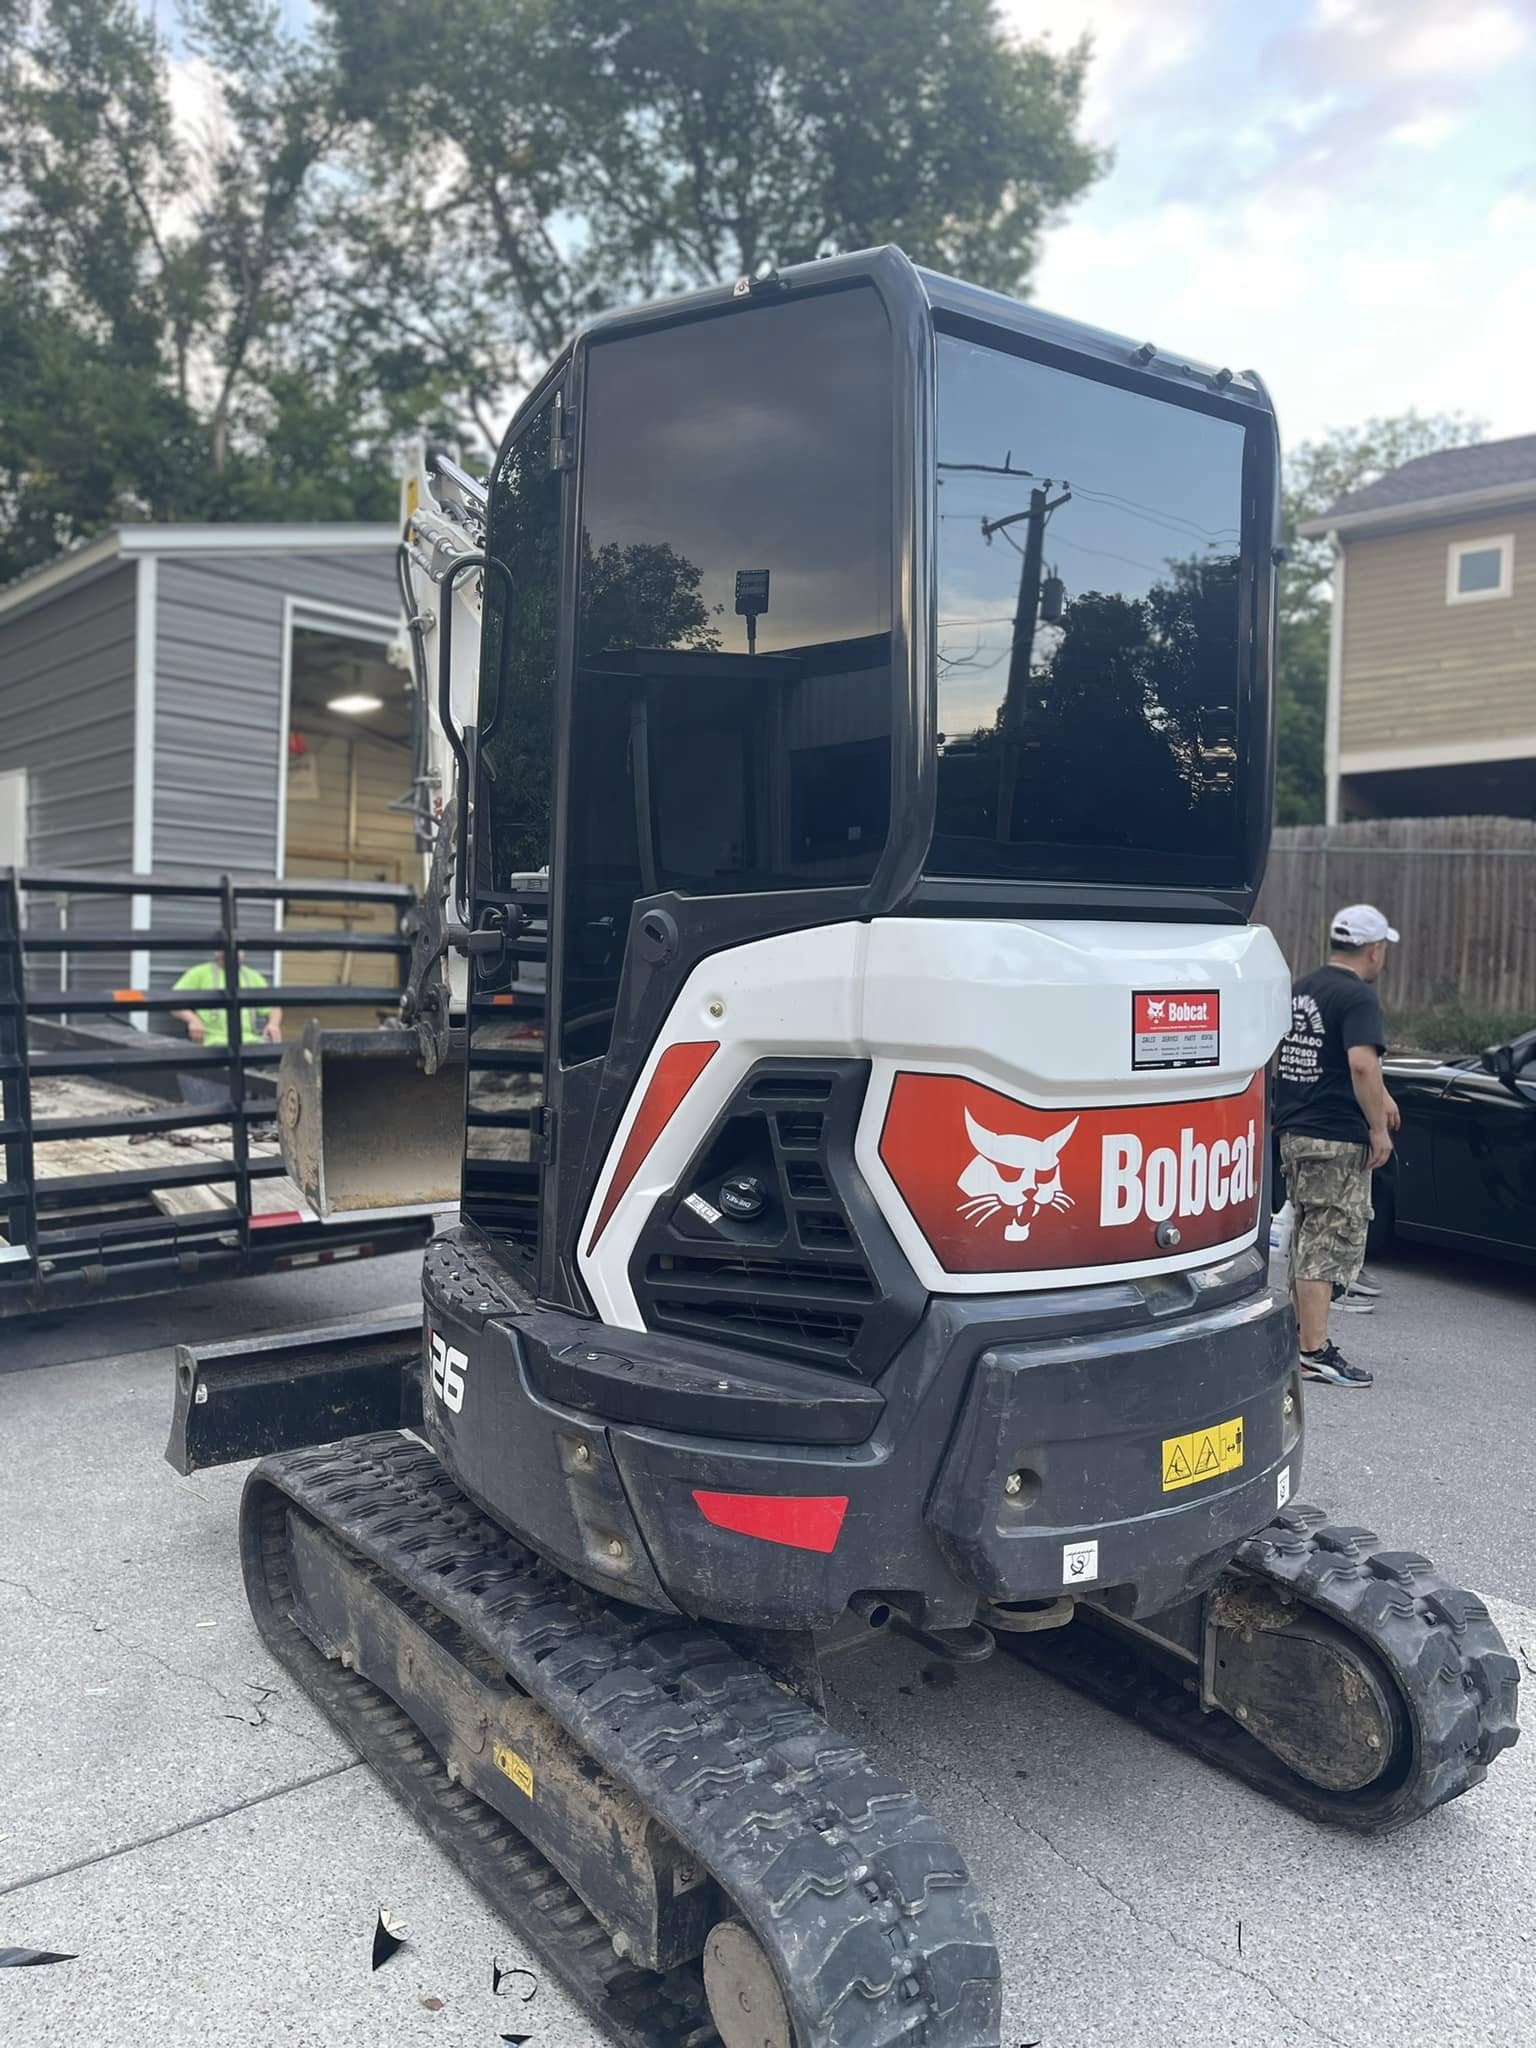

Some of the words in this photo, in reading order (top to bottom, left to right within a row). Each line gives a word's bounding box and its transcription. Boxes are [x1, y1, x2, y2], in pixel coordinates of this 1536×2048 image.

[1168, 1002, 1208, 1022] Bobcat
[1100, 1119, 1256, 1227] Bobcat
[725, 1192, 751, 1208] DIESEL
[429, 1331, 469, 1415] 26
